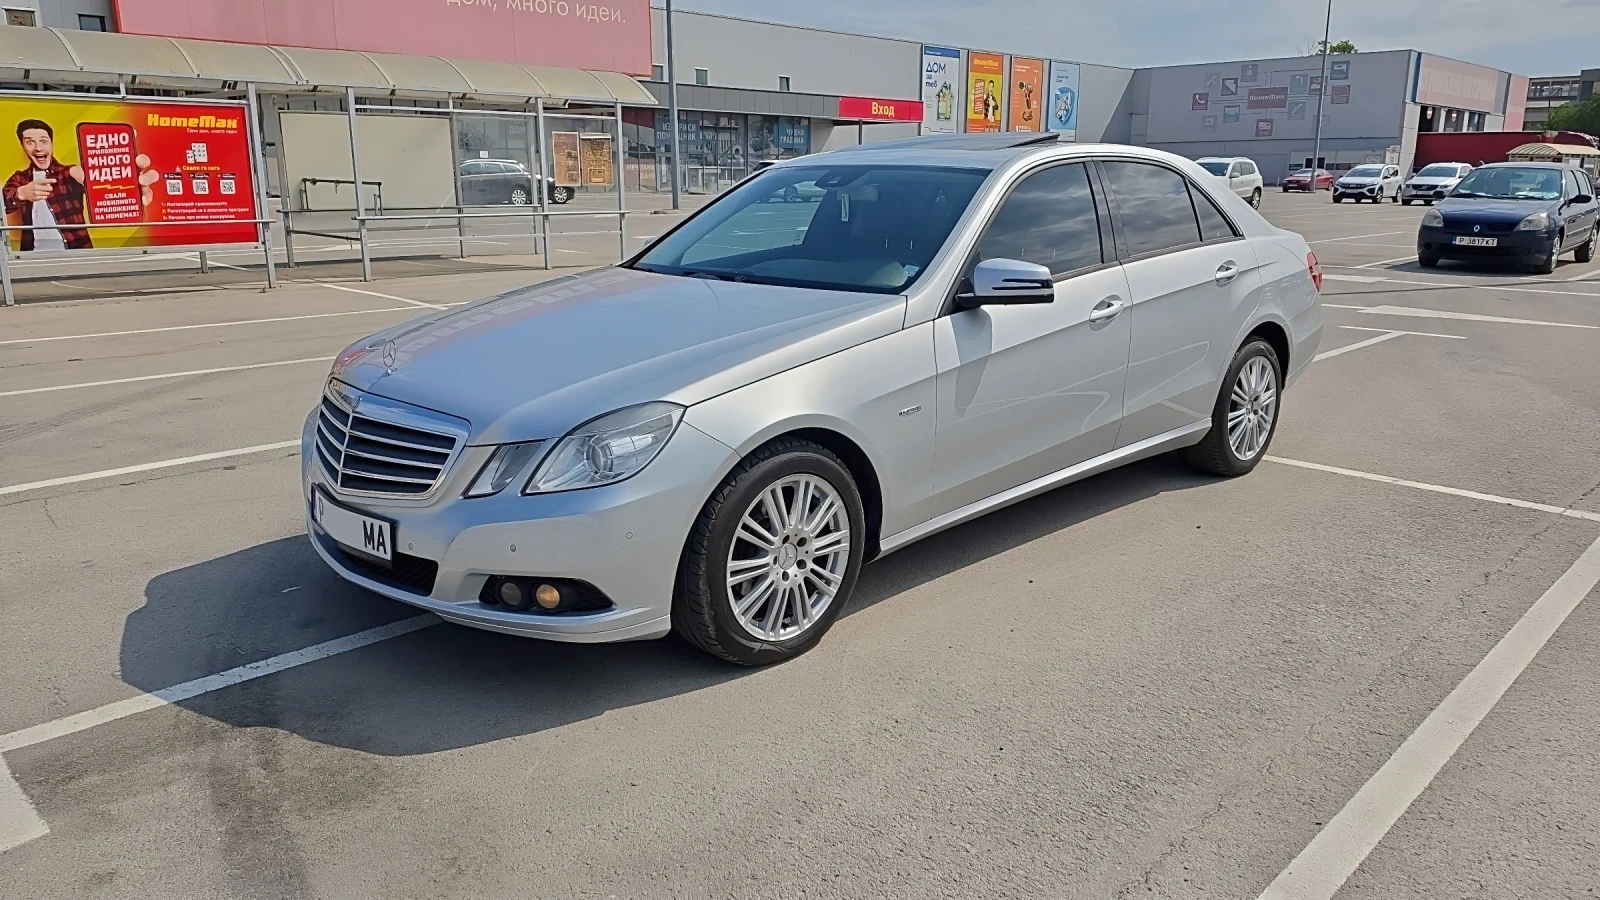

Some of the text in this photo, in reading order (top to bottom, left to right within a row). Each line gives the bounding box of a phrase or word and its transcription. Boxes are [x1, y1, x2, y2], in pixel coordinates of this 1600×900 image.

[506, 0, 568, 16] много
[576, 4, 626, 24] идеи.
[925, 62, 946, 74] ДОМ
[871, 101, 895, 118] Вход
[147, 113, 238, 129] HomeMax
[86, 132, 130, 149] ЕДНО
[87, 147, 130, 156] ПРИЛОЖЕНИЕ
[87, 154, 131, 167] МНОГО
[88, 165, 132, 182] ИДЕИ
[94, 204, 139, 213] ПРИЛОЖЕНИЕ
[97, 198, 136, 207] МОБИЛНОТО
[362, 520, 387, 555] MA
